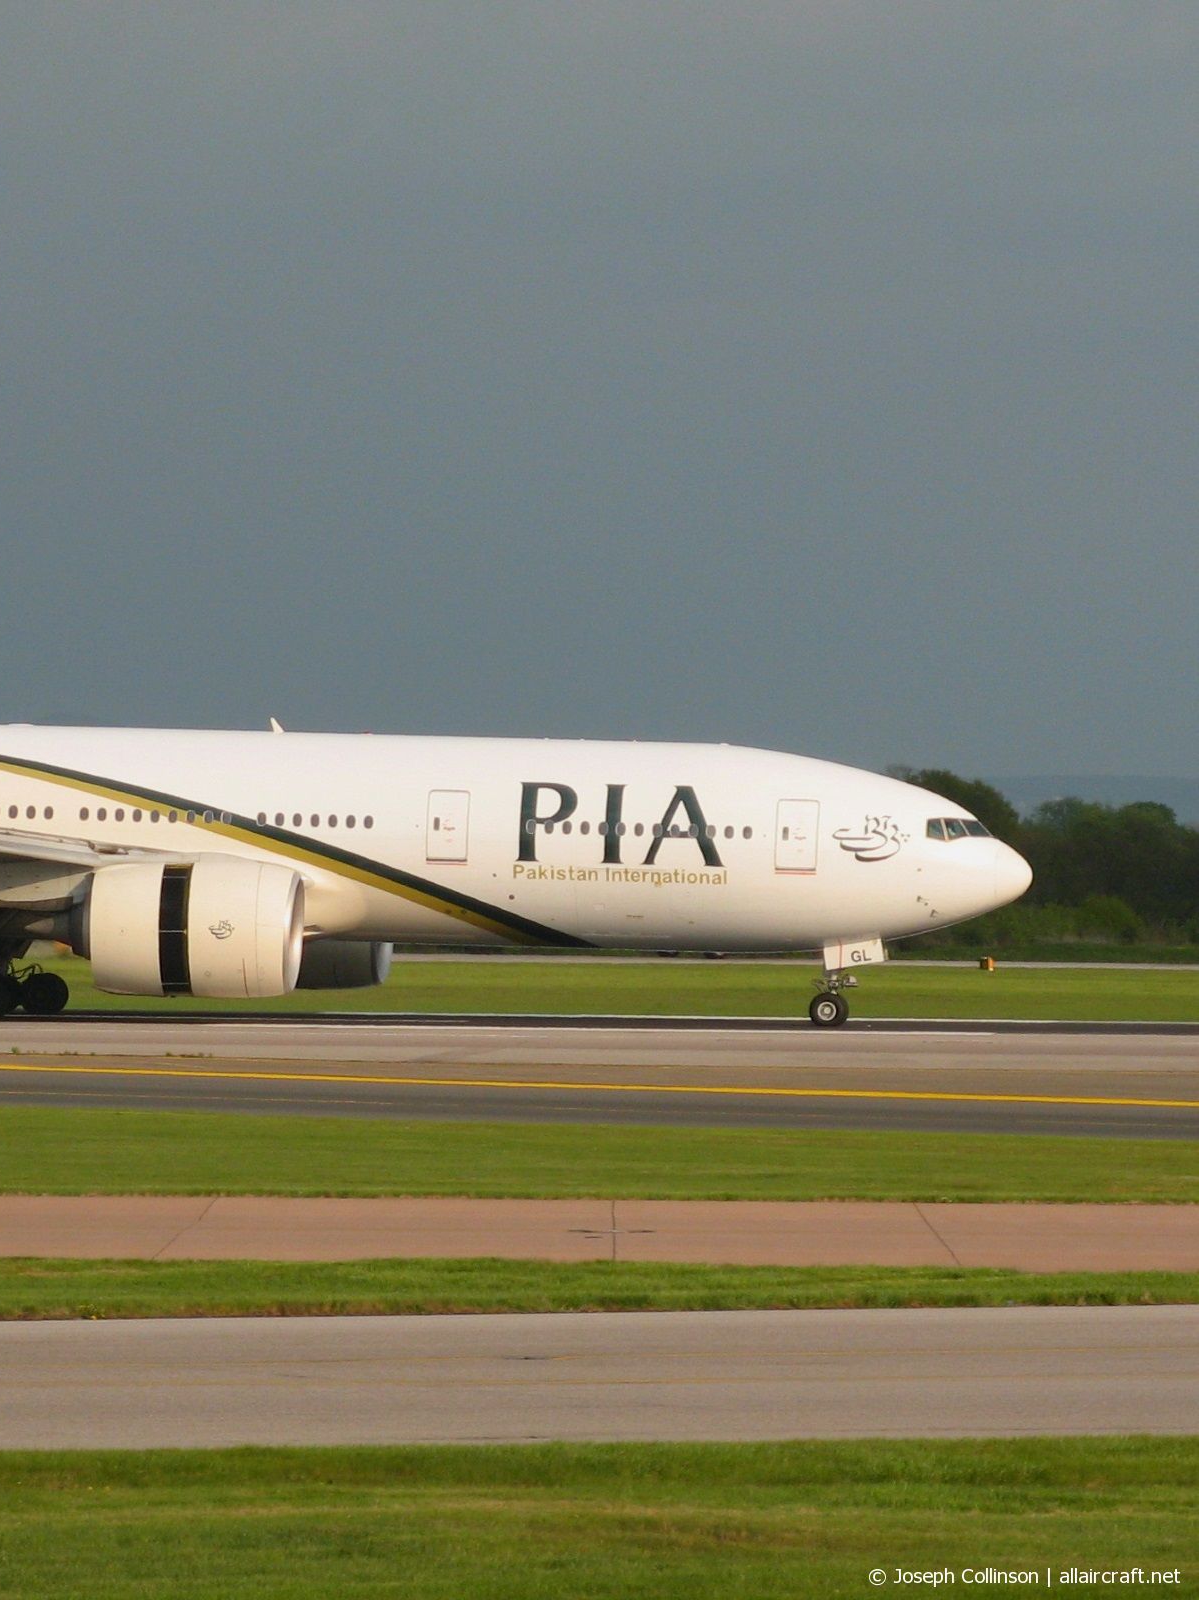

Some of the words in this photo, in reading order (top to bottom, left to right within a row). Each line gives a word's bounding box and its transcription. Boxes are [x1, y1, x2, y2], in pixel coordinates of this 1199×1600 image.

[515, 781, 726, 868] PIA
[512, 864, 599, 882] Pakistan
[605, 867, 728, 886] International
[851, 949, 872, 963] GL
